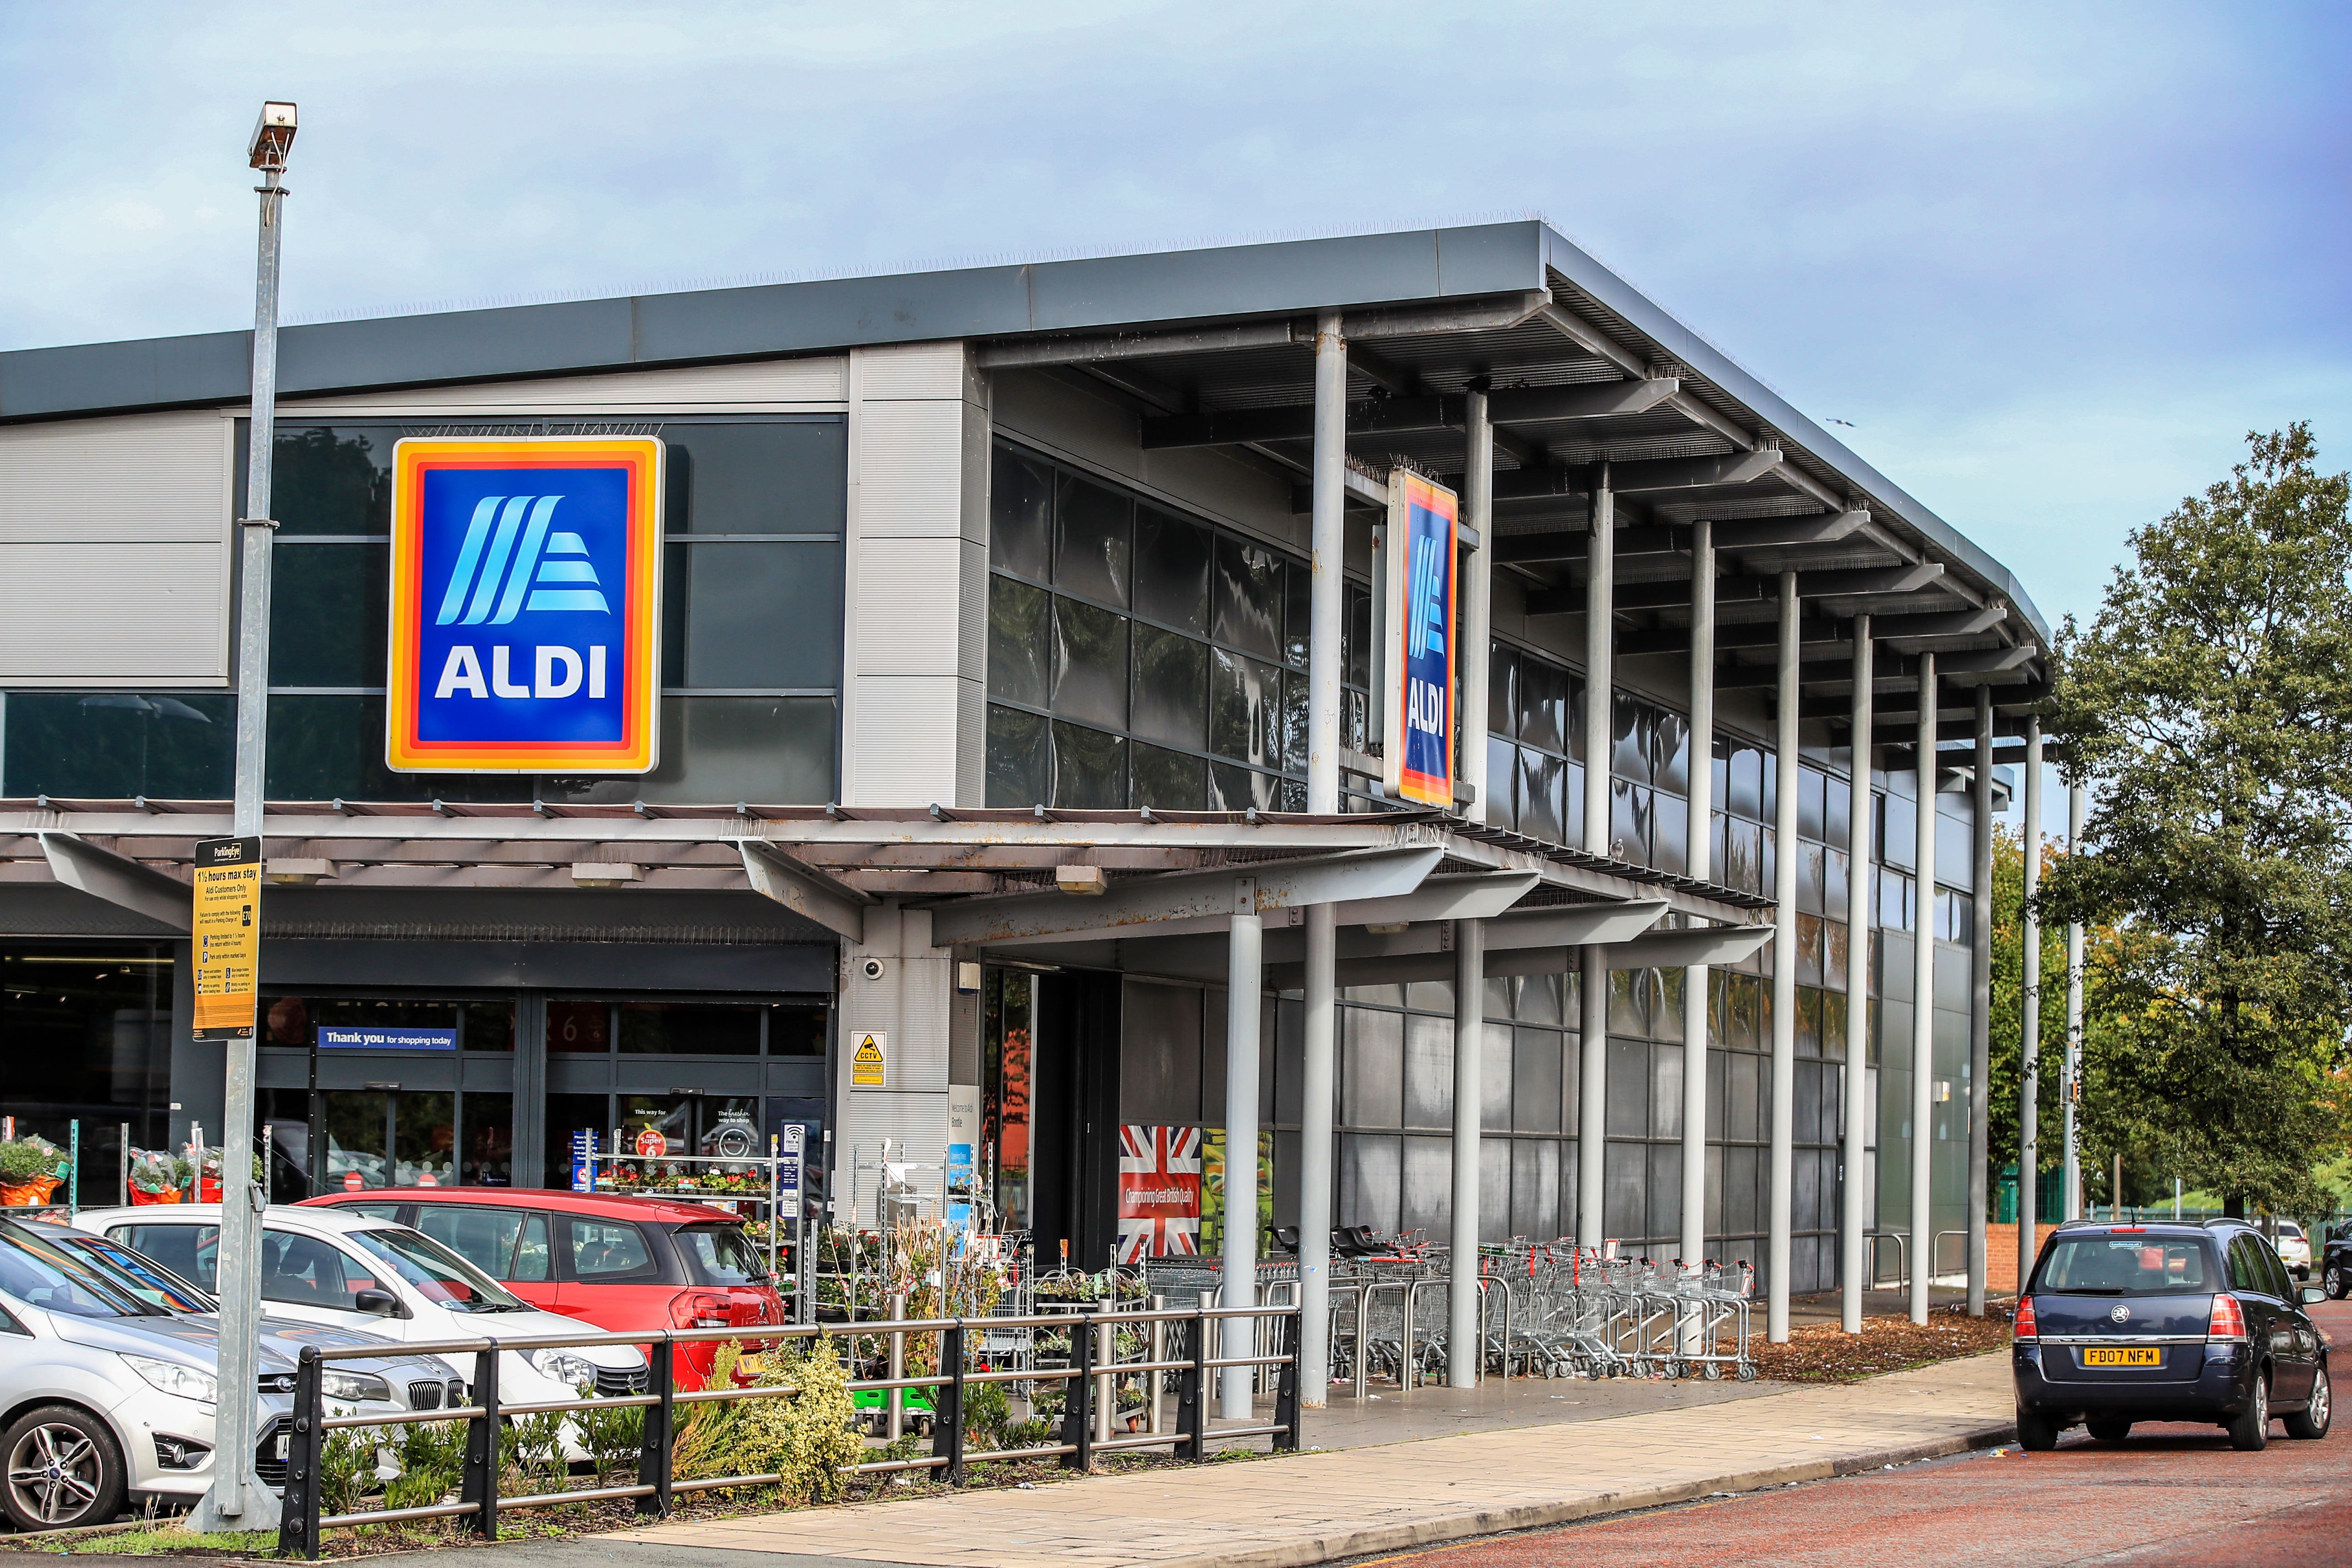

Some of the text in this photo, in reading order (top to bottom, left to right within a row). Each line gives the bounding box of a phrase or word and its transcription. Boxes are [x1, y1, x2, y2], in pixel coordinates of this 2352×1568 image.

[434, 646, 606, 698] ALDI
[1408, 676, 1443, 737] ALDI
[215, 846, 239, 857] ParkingEye
[209, 871, 226, 881] hours
[228, 871, 241, 879] max
[243, 868, 256, 880] stay
[237, 884, 246, 893] Only
[204, 952, 207, 962] P
[563, 1016, 577, 1041] 6
[327, 1032, 362, 1043] Thank
[363, 1034, 384, 1045] you
[398, 1036, 431, 1045] shopping
[432, 1037, 451, 1046] today
[728, 1109, 750, 1117] fresher
[952, 1103, 964, 1112] Welcome
[952, 1117, 962, 1127] Bootle
[646, 1145, 657, 1156] 6
[1126, 1187, 1193, 1207] Championing Great British Quality
[2090, 1350, 2153, 1362] FD07 NFM
[743, 1357, 756, 1370] MK17
